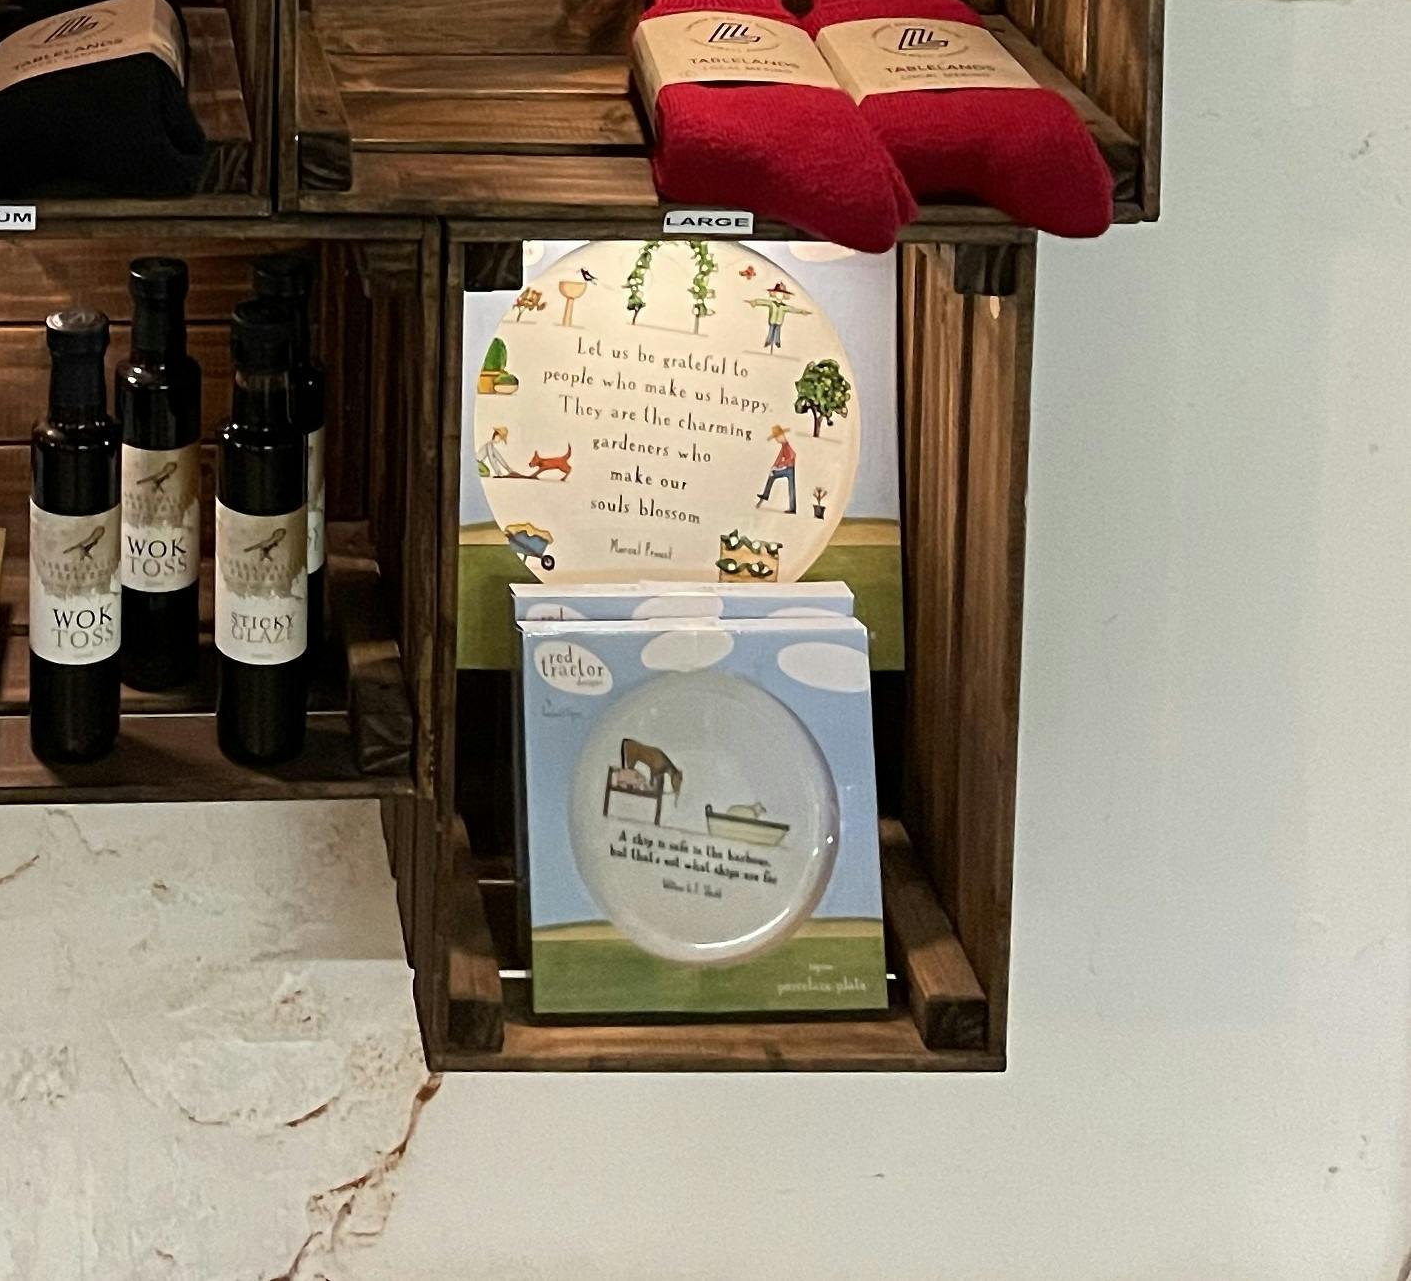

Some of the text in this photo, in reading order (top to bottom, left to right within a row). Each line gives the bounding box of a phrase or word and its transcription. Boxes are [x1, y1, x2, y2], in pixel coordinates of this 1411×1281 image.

[666, 216, 750, 229] LARGE
[577, 337, 749, 379] Let us be grateful to
[610, 467, 688, 491] make our
[590, 494, 700, 524] souls blossom
[126, 534, 187, 559] WOK
[127, 555, 187, 578] TOSS
[52, 603, 112, 629] WOK
[230, 612, 295, 629] STICKY
[51, 624, 114, 649] TOSS
[548, 645, 573, 665] red
[541, 657, 604, 679] tractor
